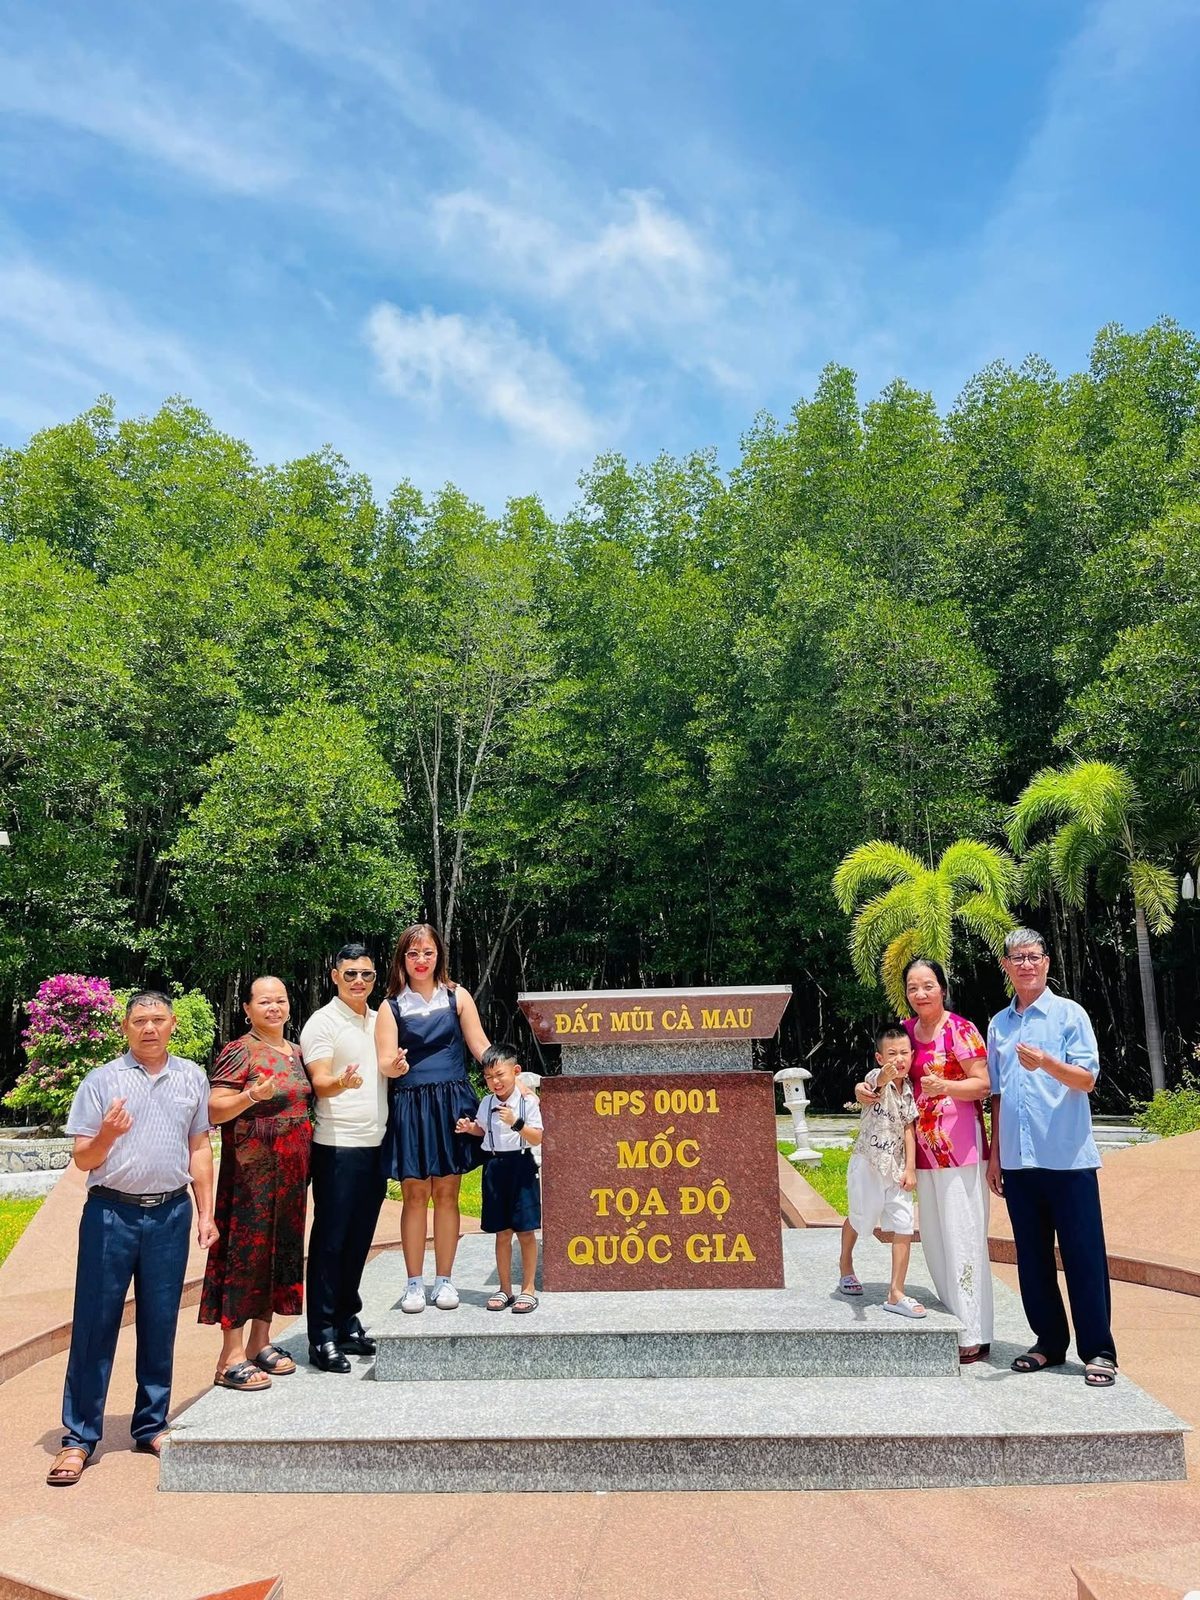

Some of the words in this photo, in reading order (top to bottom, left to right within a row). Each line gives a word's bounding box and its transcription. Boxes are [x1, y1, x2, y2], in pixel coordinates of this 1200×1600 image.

[554, 1003, 603, 1034] ĐẤT
[610, 1006, 655, 1032] MŨI
[661, 1004, 695, 1030] CÀ
[701, 1008, 753, 1029] MAU
[594, 1090, 646, 1116] GPS
[654, 1089, 720, 1114] 0001
[616, 1126, 701, 1169] MỐC
[589, 1187, 669, 1223] TỌA
[678, 1178, 731, 1220] ĐỘ
[567, 1220, 672, 1266] QUỐC
[686, 1233, 757, 1263] GIA
